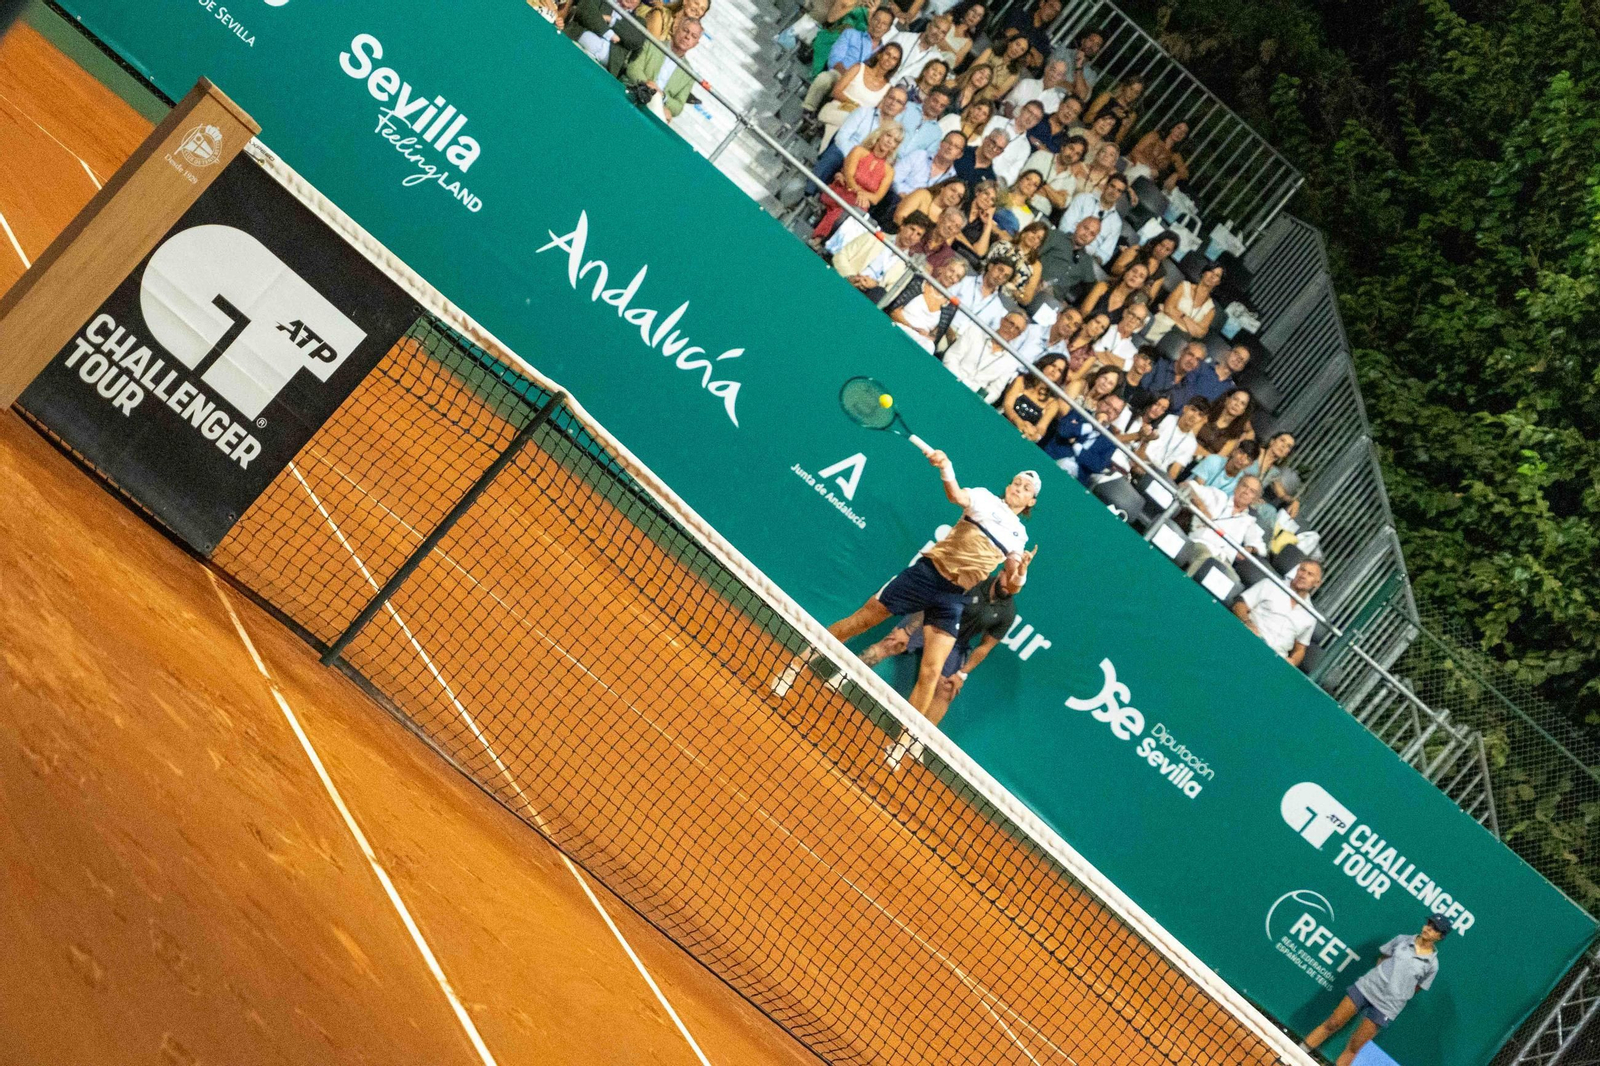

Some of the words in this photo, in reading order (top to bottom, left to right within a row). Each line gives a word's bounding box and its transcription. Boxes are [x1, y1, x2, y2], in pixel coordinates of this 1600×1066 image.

[214, 7, 256, 47] SEVILLA
[339, 33, 481, 173] Sevilla
[164, 153, 184, 173] Desde
[182, 169, 198, 184] 1929
[275, 319, 338, 364] ATP
[535, 209, 746, 428] Andalucía
[64, 336, 145, 417] TOUR
[85, 313, 262, 470] CHALLENGER
[790, 463, 816, 487] Junta
[814, 483, 827, 495] de
[824, 492, 867, 530] Andalucía
[1136, 737, 1203, 799] Sevilla
[1151, 722, 1215, 781] Diputación
[1326, 814, 1347, 829] ATP
[1333, 842, 1391, 900] TOUR
[1349, 824, 1475, 937] CHALLENGER
[1275, 942, 1308, 971] ESPAÑOLA
[1306, 966, 1317, 978] DE
[1315, 974, 1334, 992] TENIS
[1281, 935, 1298, 952] REAL
[1298, 949, 1336, 982] FEDERACIÓN
[1289, 912, 1361, 973] RFET
